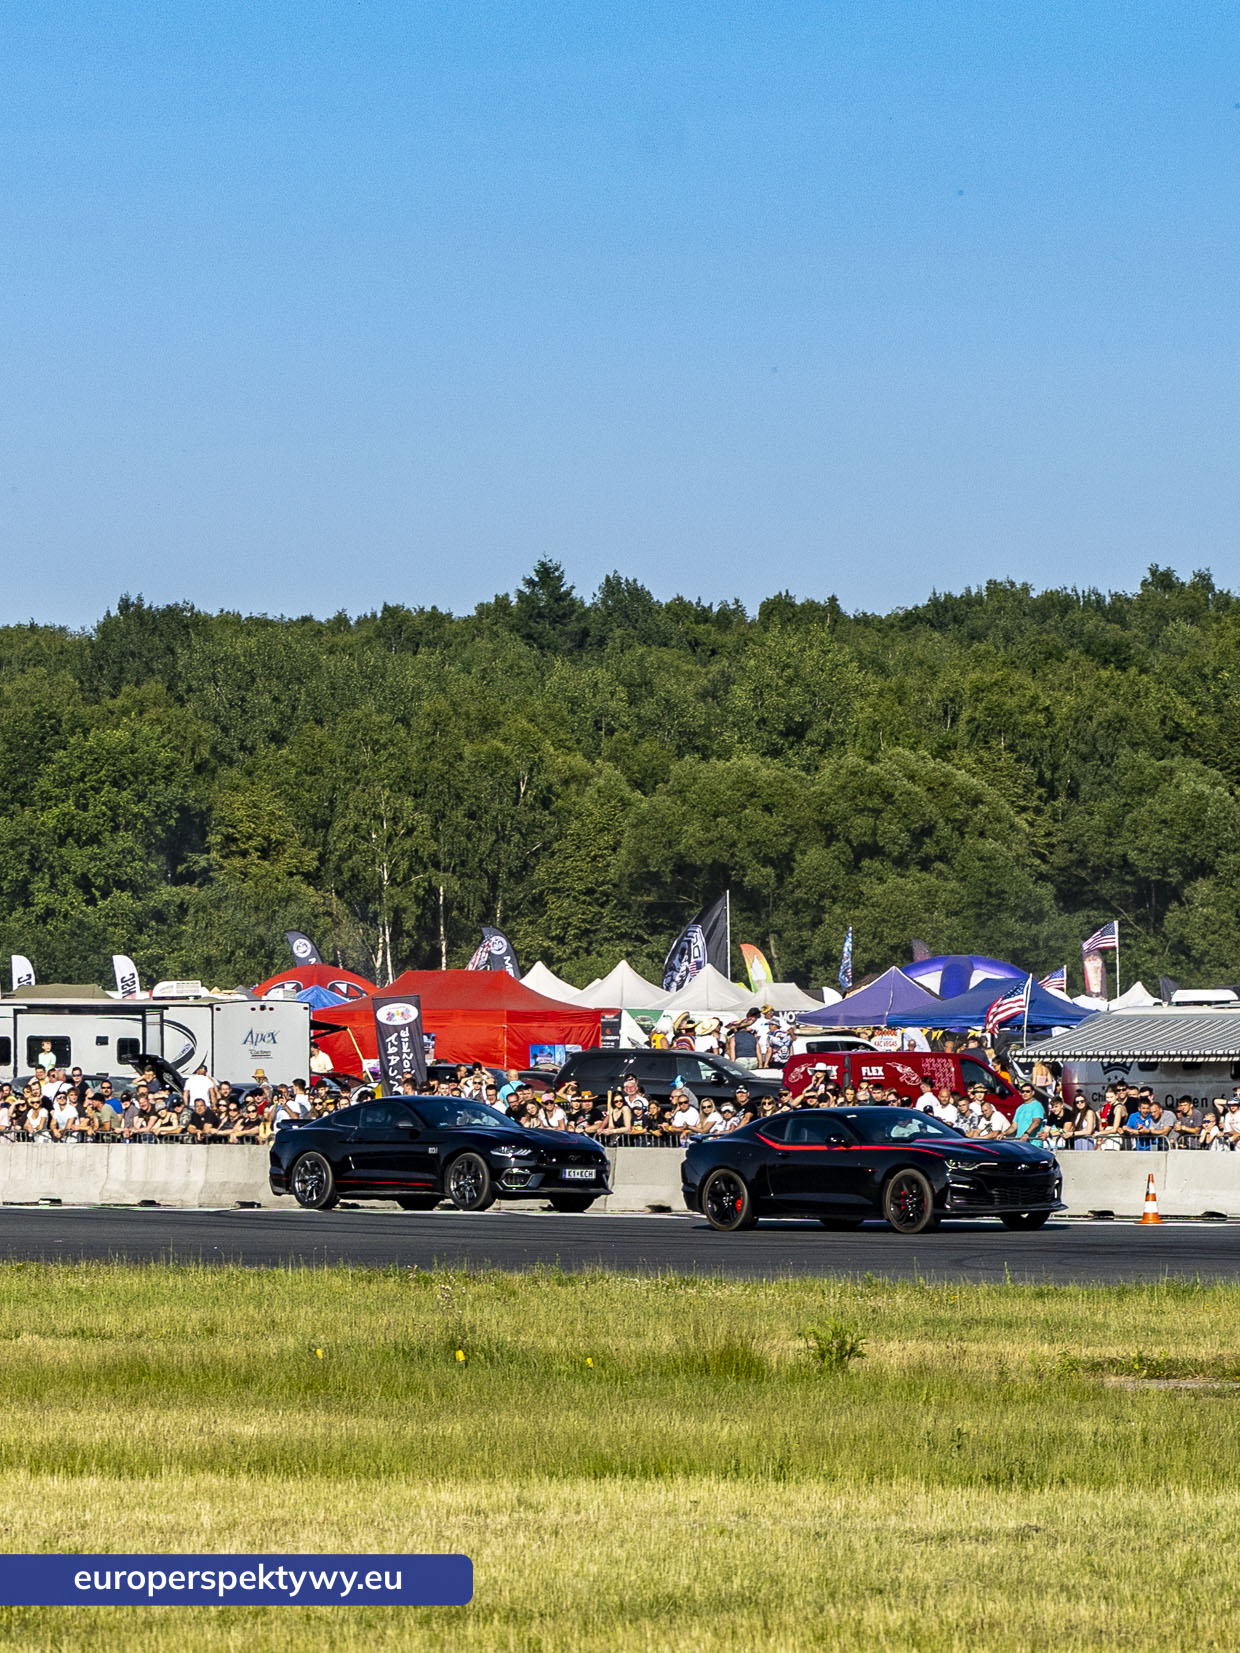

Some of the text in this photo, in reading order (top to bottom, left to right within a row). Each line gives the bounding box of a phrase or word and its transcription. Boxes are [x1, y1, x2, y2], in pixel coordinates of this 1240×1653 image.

[242, 1026, 280, 1046] Apex
[861, 1066, 885, 1076] FLEX
[1165, 1094, 1208, 1109] Qen
